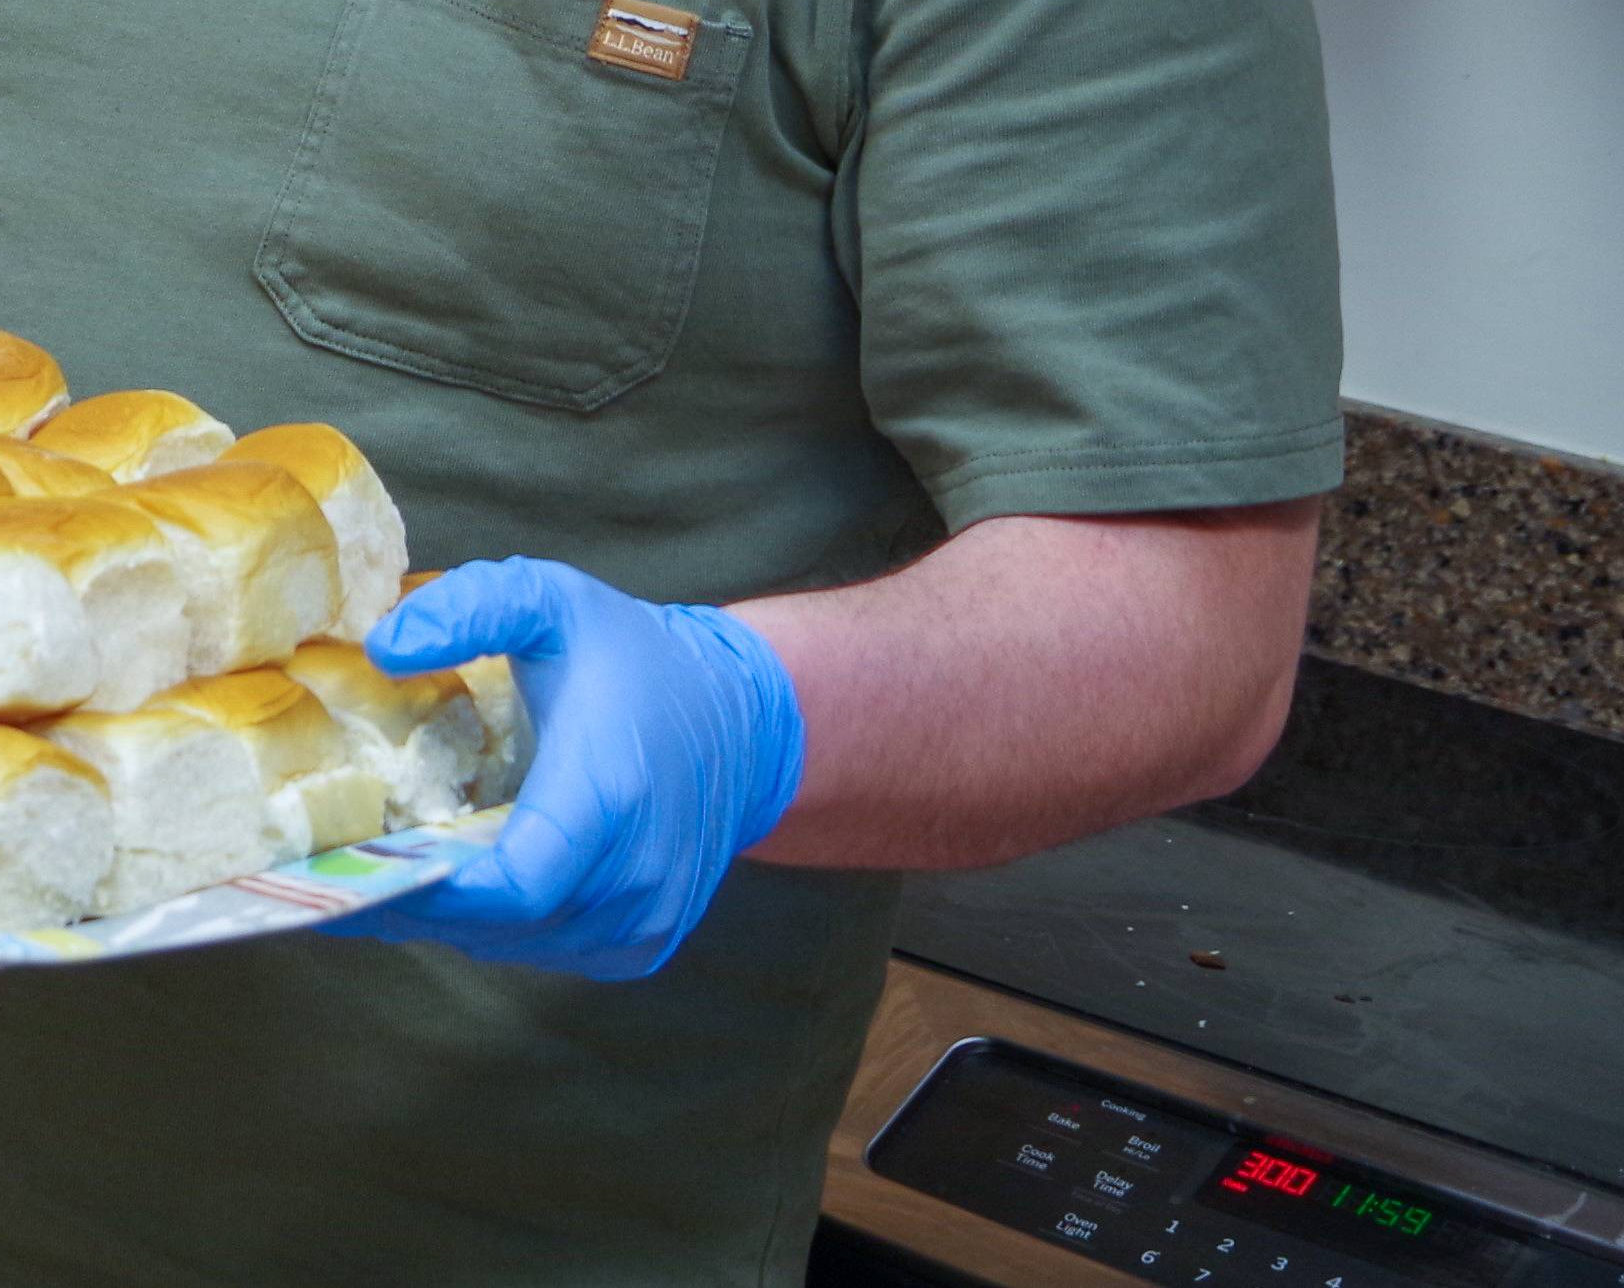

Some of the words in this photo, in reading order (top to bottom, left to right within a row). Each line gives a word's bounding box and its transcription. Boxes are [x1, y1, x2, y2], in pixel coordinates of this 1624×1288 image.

[1100, 1099, 1147, 1122] Cooking
[1047, 1112, 1080, 1130] Bake
[1021, 1144, 1055, 1163] Cook
[1127, 1135, 1161, 1154] Broil
[1015, 1152, 1049, 1171] Time
[1096, 1170, 1134, 1191] Delay
[1234, 1149, 1319, 1197] 300
[1093, 1179, 1126, 1198] Time
[1331, 1183, 1433, 1236] 11:59
[1055, 1220, 1093, 1241] Light
[1064, 1212, 1099, 1231] Oven
[1165, 1219, 1180, 1235] 1
[1216, 1237, 1235, 1253] 2
[1140, 1250, 1161, 1265] 6
[1271, 1256, 1289, 1272] 3
[1194, 1268, 1212, 1282] 7
[1325, 1276, 1343, 1288] 4
